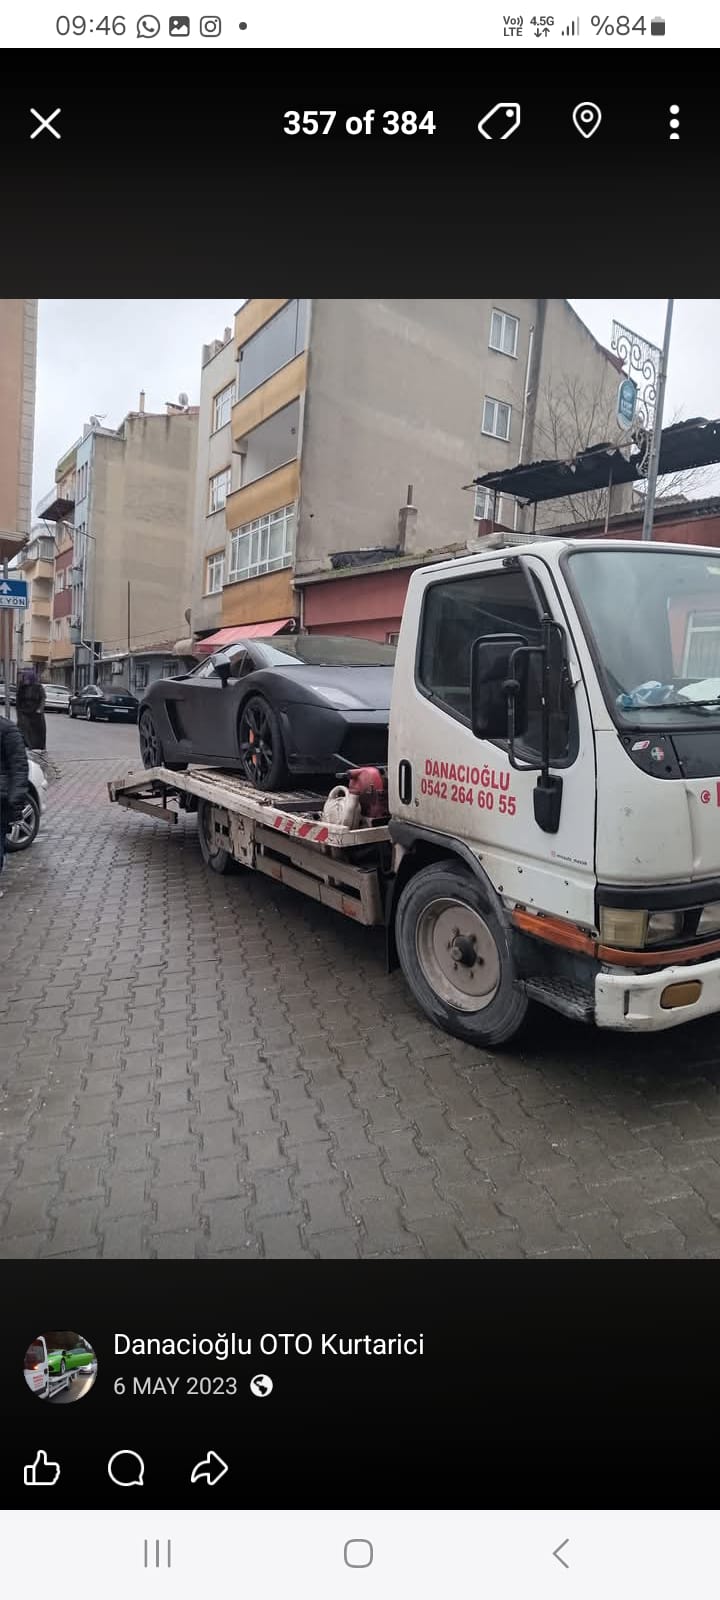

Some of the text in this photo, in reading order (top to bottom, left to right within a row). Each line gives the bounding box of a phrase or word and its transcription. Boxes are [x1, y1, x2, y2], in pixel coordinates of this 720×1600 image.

[425, 759, 510, 791] DANACIOĞLU
[421, 778, 516, 815] 0542 264 60 55
